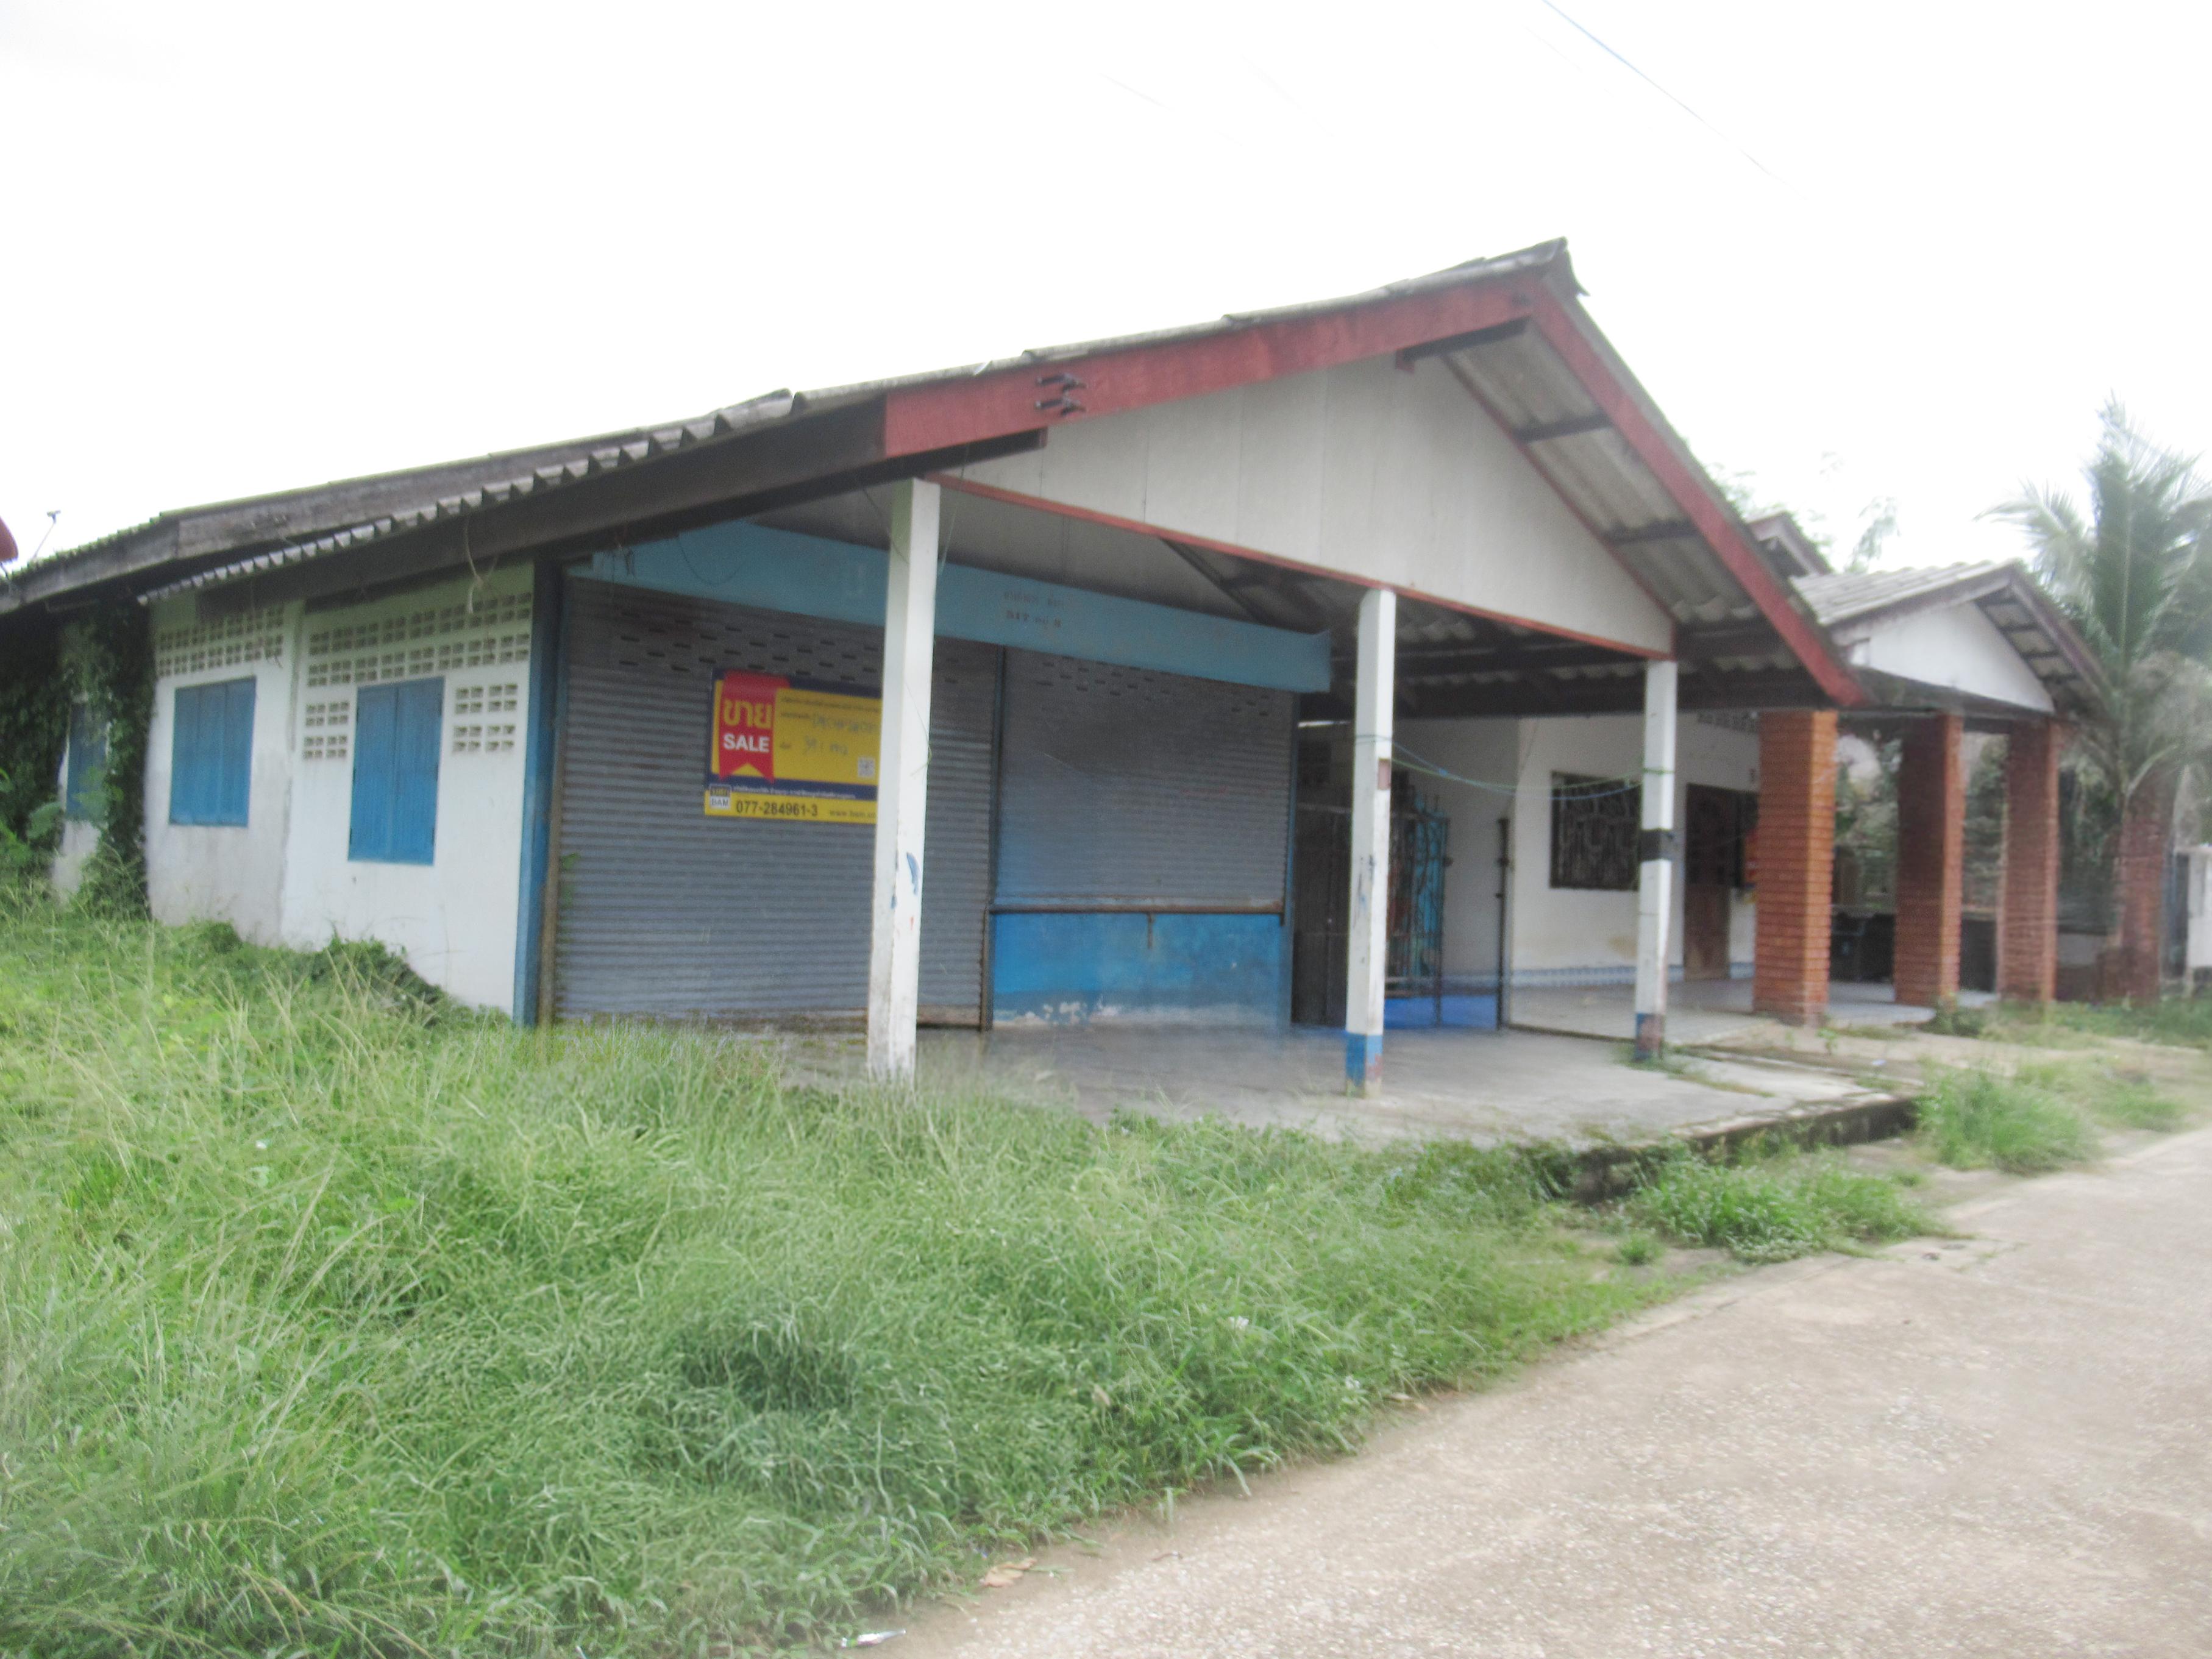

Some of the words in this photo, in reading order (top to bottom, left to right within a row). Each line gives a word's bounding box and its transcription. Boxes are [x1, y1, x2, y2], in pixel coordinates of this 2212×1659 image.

[724, 700, 772, 729] ขาย
[723, 733, 770, 753] SALE
[711, 798, 729, 807] BAM
[736, 800, 819, 817] 077-284961-3
